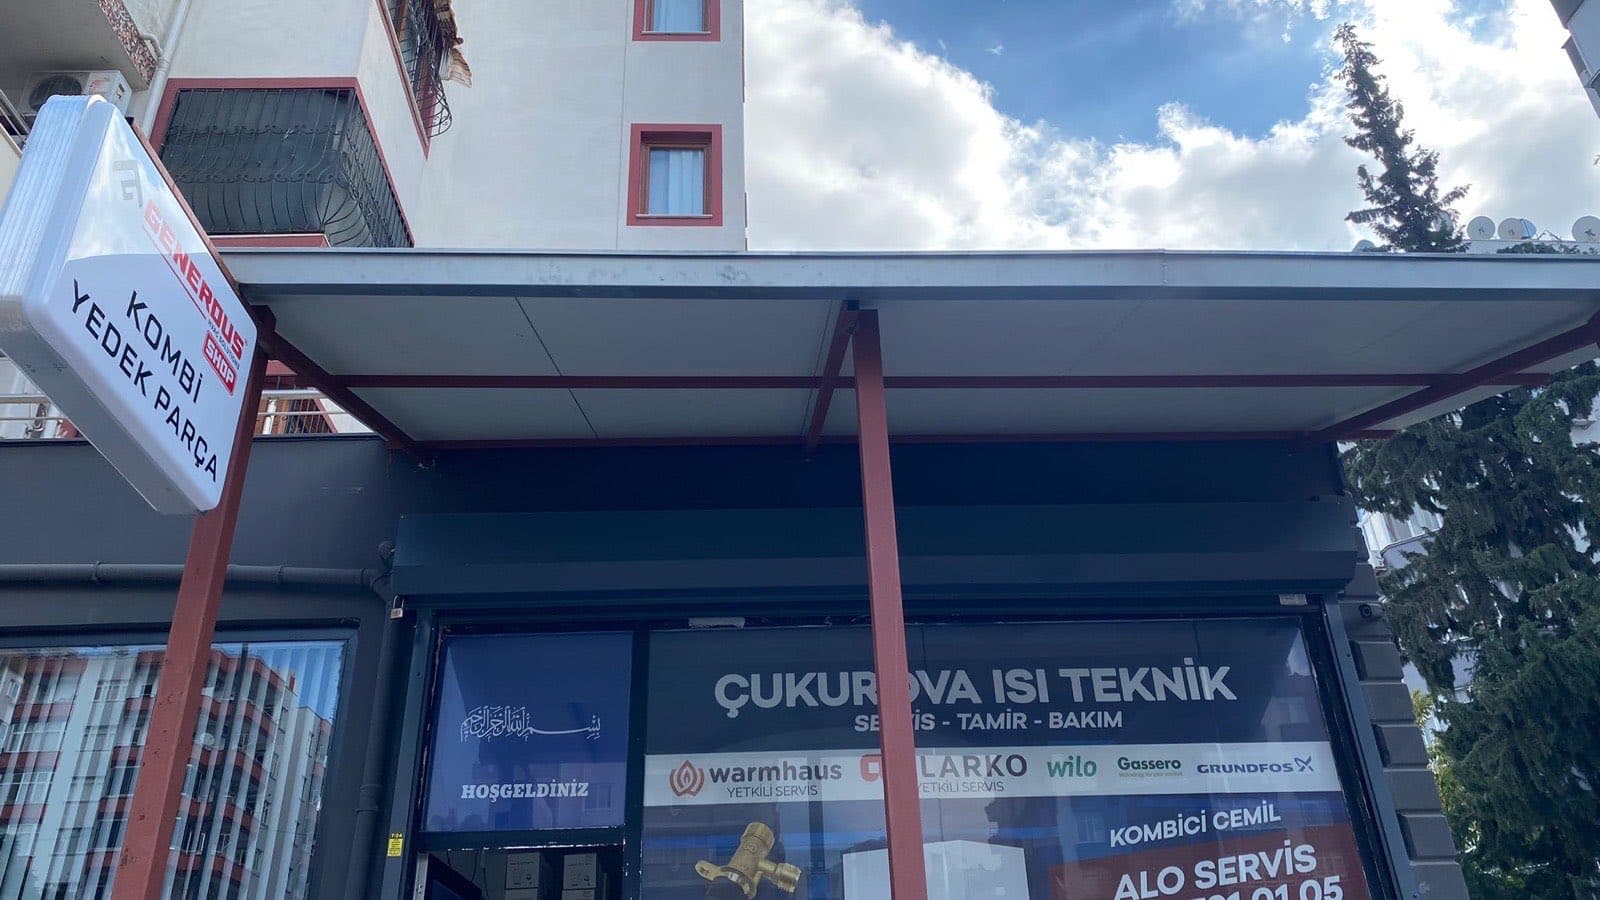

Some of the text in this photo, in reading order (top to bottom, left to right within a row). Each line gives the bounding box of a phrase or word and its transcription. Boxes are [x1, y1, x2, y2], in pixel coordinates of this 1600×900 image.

[143, 199, 245, 360] GENEROUS
[126, 290, 203, 404] KOMBİ
[205, 338, 235, 384] SHOP
[71, 279, 218, 482] YEDEK PARÇA
[992, 669, 1049, 704] ISI
[1059, 657, 1237, 702] TEKNİK
[854, 709, 936, 732] SEİS
[957, 709, 1027, 730] TAMİR
[1049, 711, 1123, 729] BAKIM
[709, 761, 842, 784] warmhaus
[920, 754, 1028, 778] LARKO
[1047, 756, 1097, 778] wilo
[1117, 756, 1182, 771] Gassero
[1197, 762, 1294, 774] GRUNDFOS
[461, 779, 589, 802] HOŞGELDİNİZ
[727, 784, 773, 798] YETKİLİ
[1110, 800, 1281, 847] KOMBİCİ CEMİL
[1113, 866, 1185, 900] ALO
[1194, 840, 1317, 889] SERVİS
